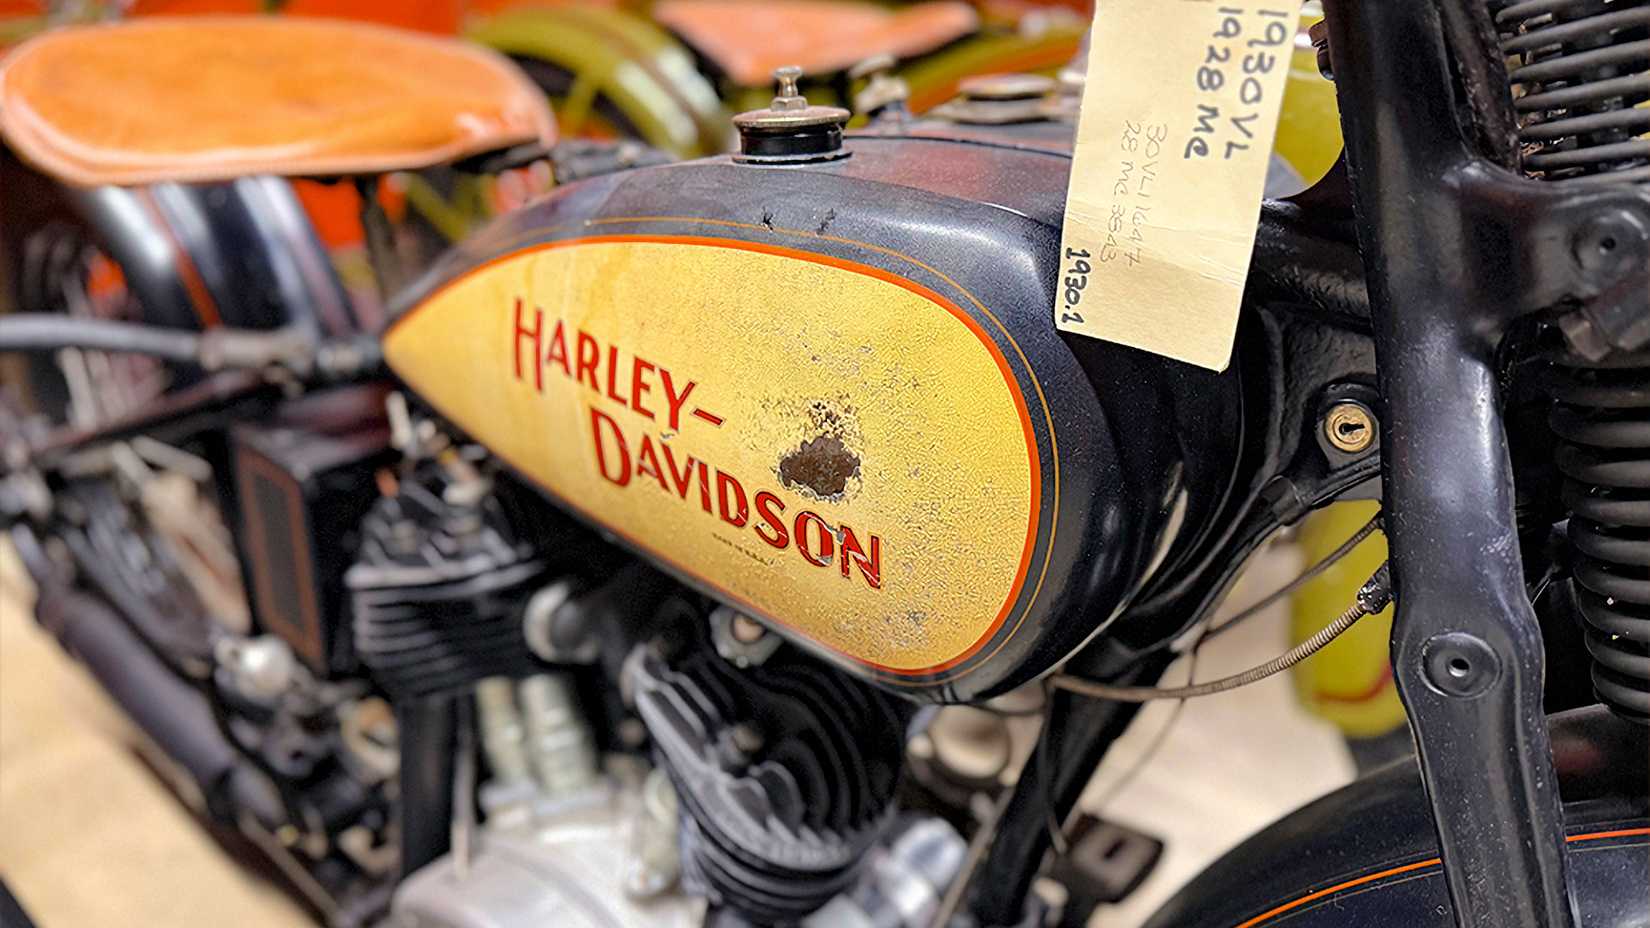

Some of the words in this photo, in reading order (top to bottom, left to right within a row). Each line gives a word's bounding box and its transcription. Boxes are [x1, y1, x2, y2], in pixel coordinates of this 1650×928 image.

[1197, 7, 1243, 91] 1928
[1062, 247, 1090, 326] 1930.1
[591, 407, 881, 589] DAVIDSON
